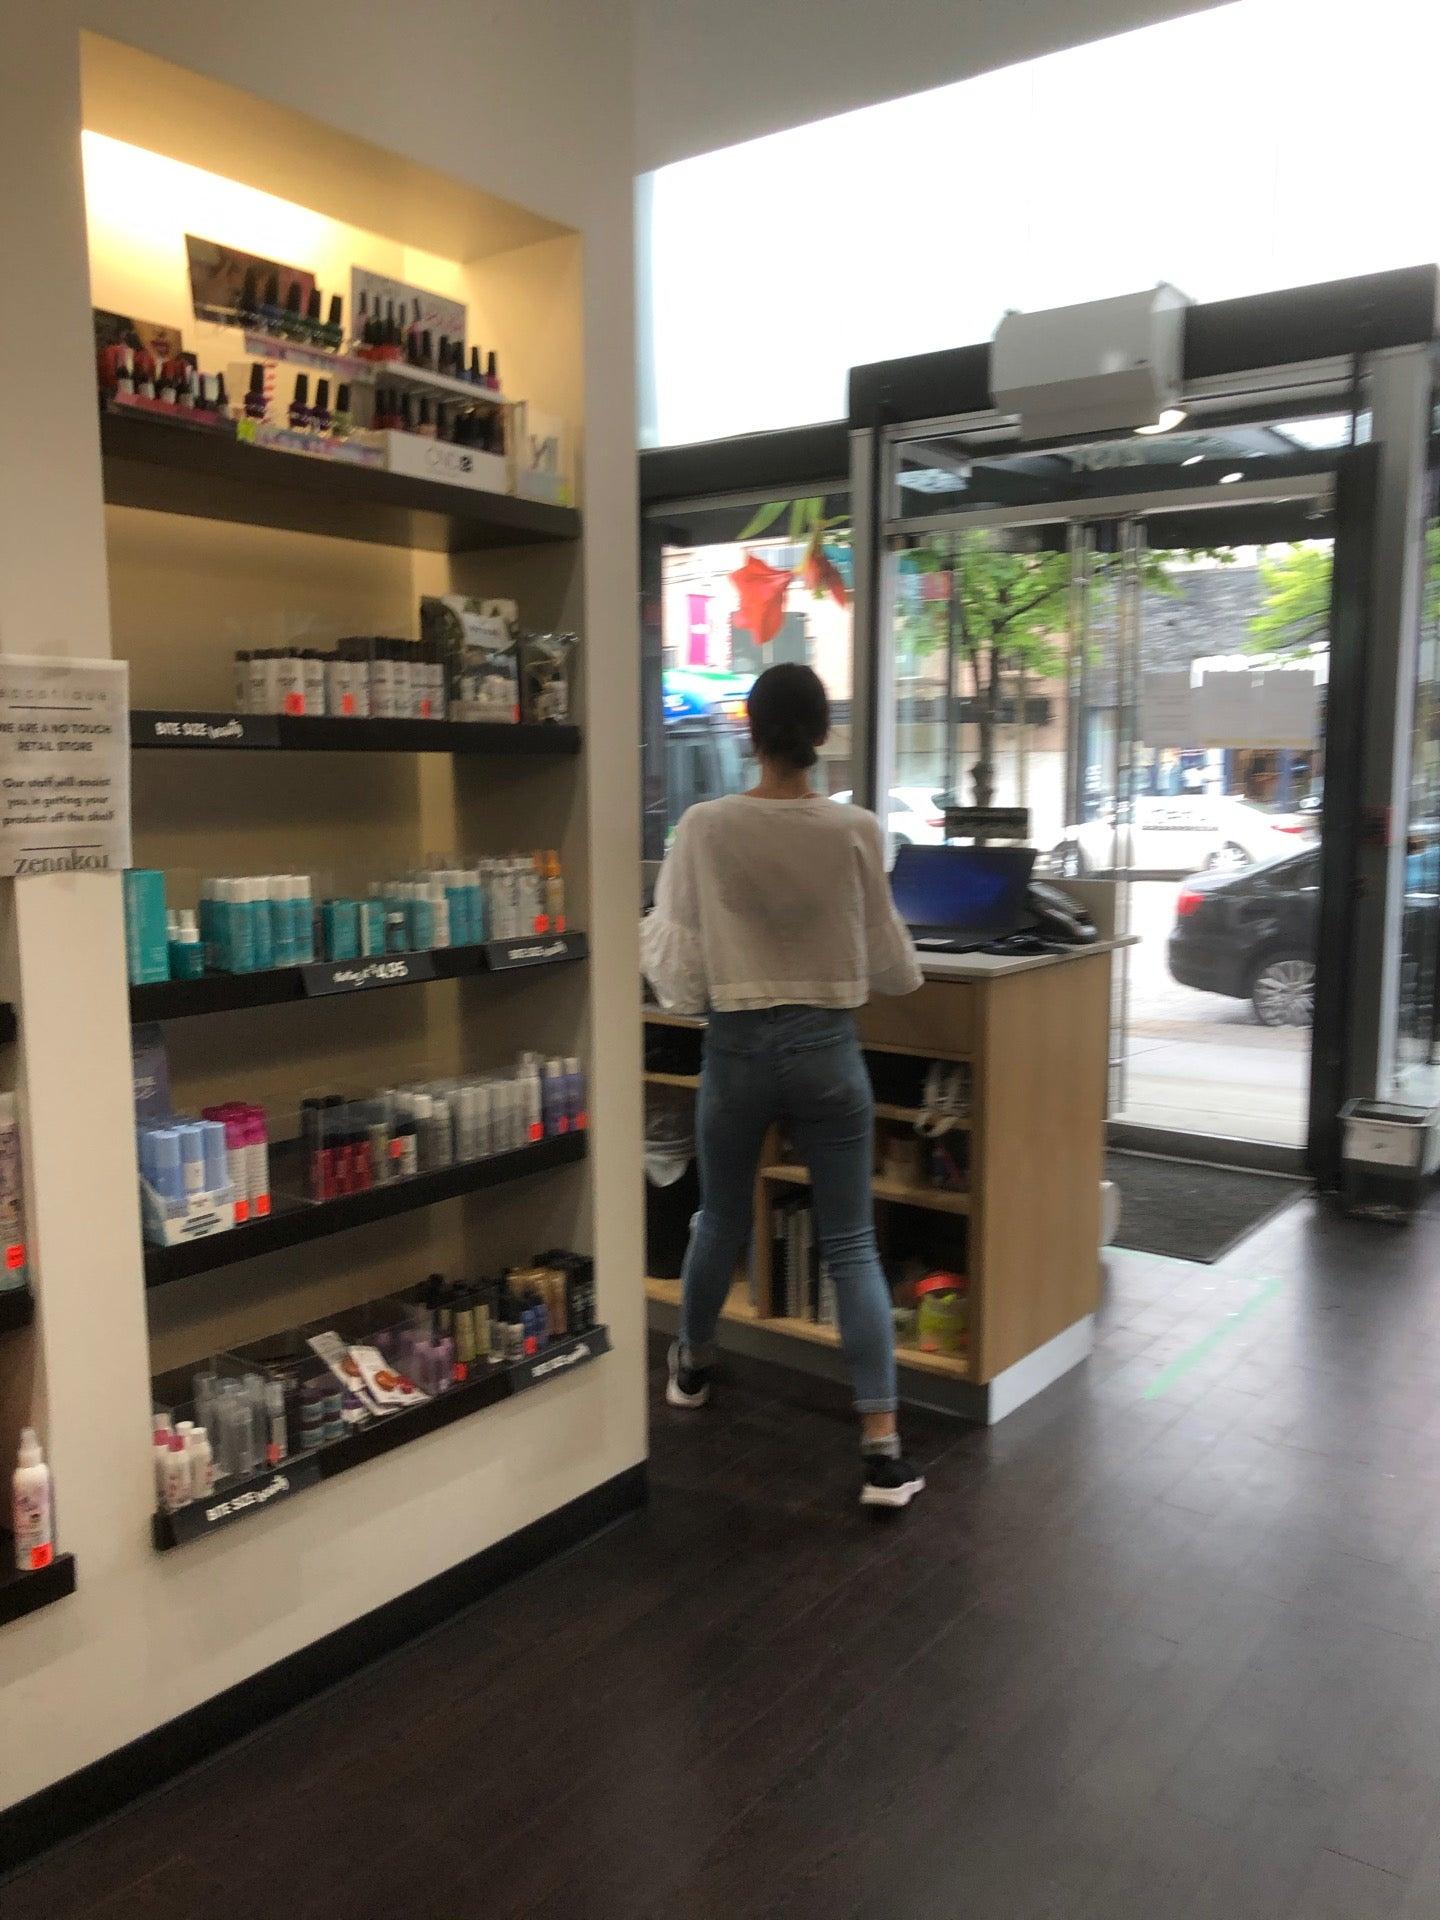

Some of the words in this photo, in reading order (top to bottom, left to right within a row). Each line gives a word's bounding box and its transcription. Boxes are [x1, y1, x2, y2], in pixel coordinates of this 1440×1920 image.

[18, 723, 39, 733] ARE
[51, 724, 69, 734] NO
[182, 722, 207, 736] SIZE
[58, 741, 93, 752] STORE
